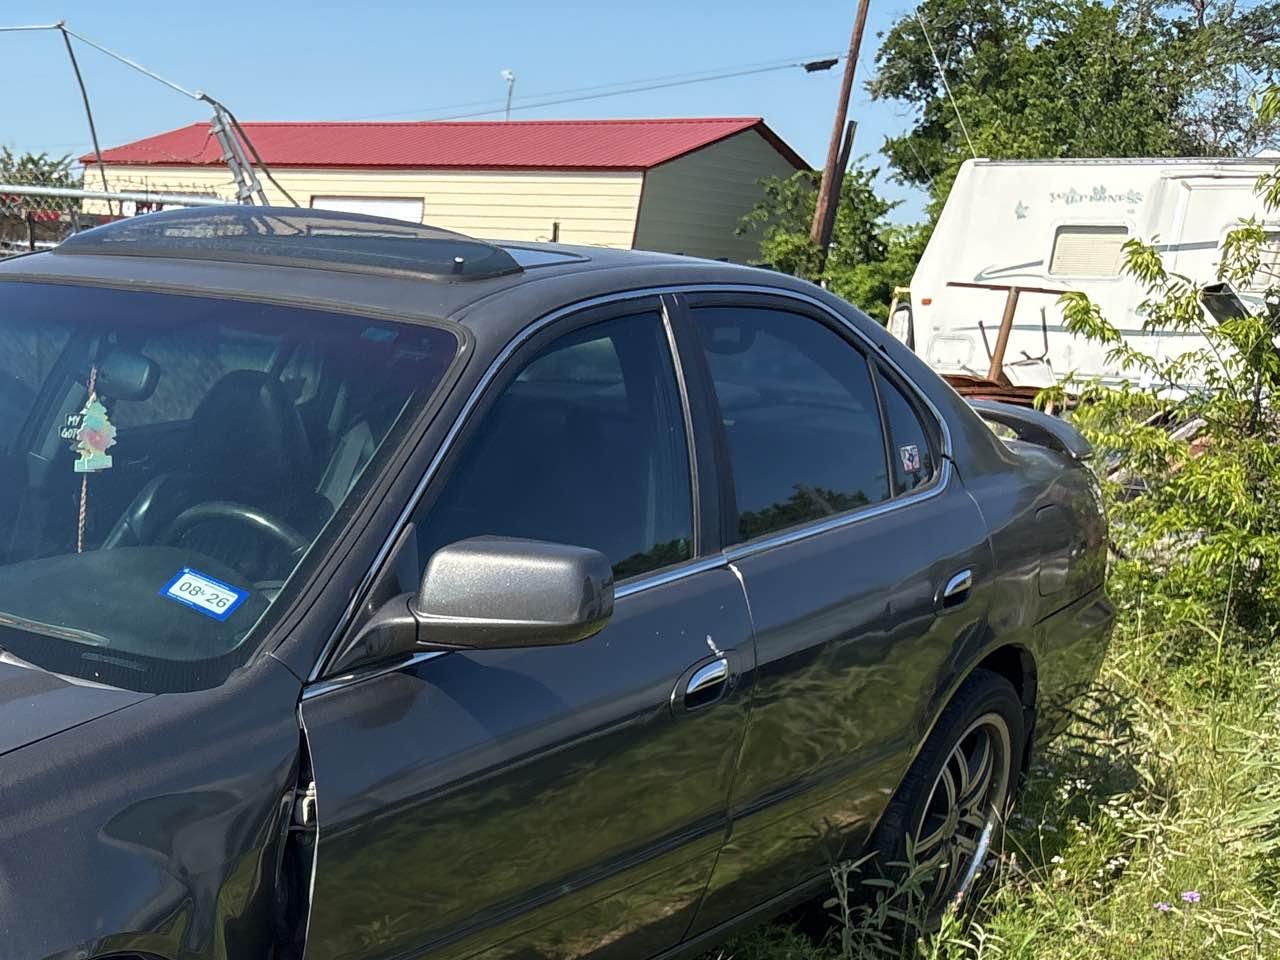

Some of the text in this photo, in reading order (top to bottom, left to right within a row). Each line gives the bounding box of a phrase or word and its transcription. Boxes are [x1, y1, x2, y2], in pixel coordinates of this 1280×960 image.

[67, 415, 81, 426] MY
[179, 581, 201, 597] 08
[205, 592, 230, 609] 26
